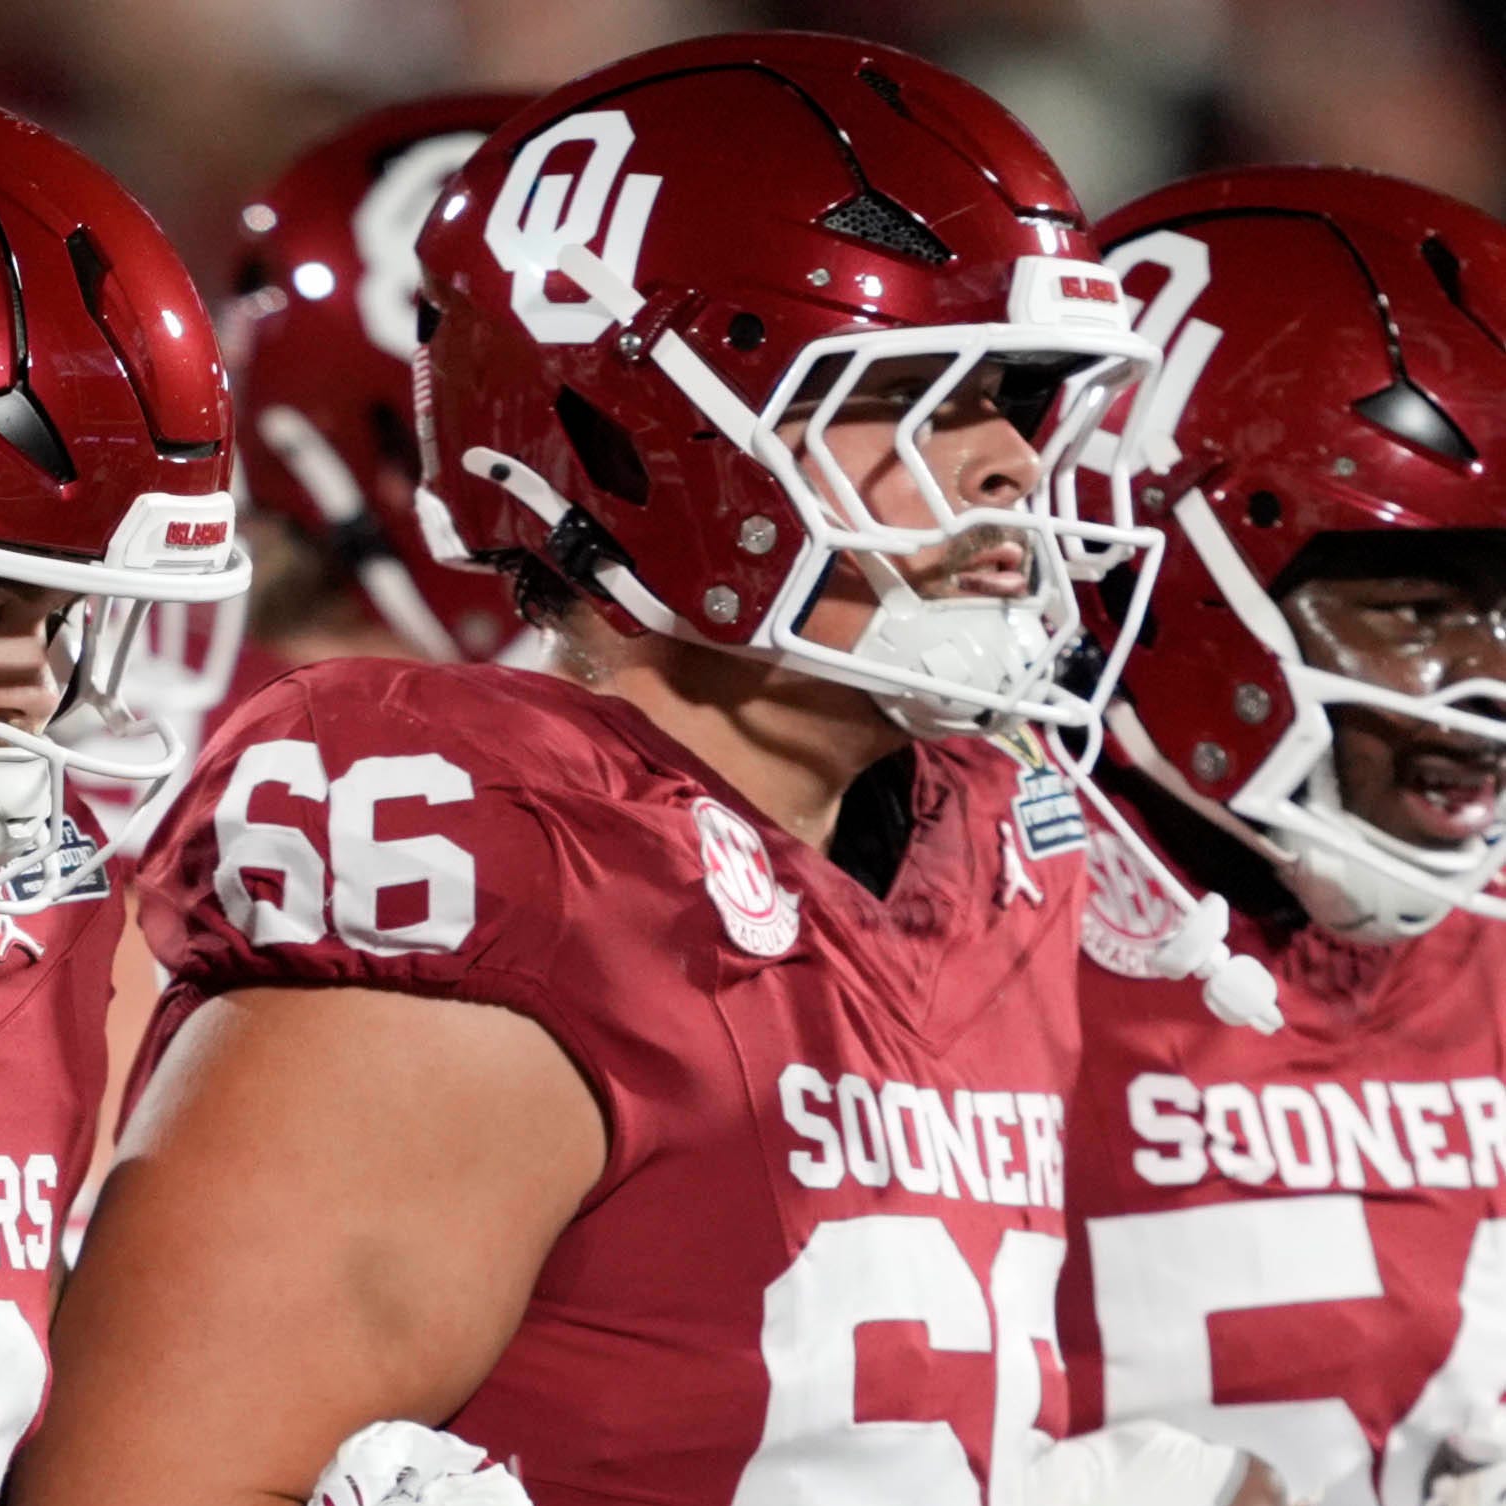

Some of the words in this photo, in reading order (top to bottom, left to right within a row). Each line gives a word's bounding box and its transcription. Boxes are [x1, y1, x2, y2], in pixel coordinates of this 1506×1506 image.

[484, 110, 663, 344] OU
[213, 739, 477, 957] 66
[778, 1063, 1065, 1211] SOONERS
[1126, 1073, 1506, 1189] SOONER
